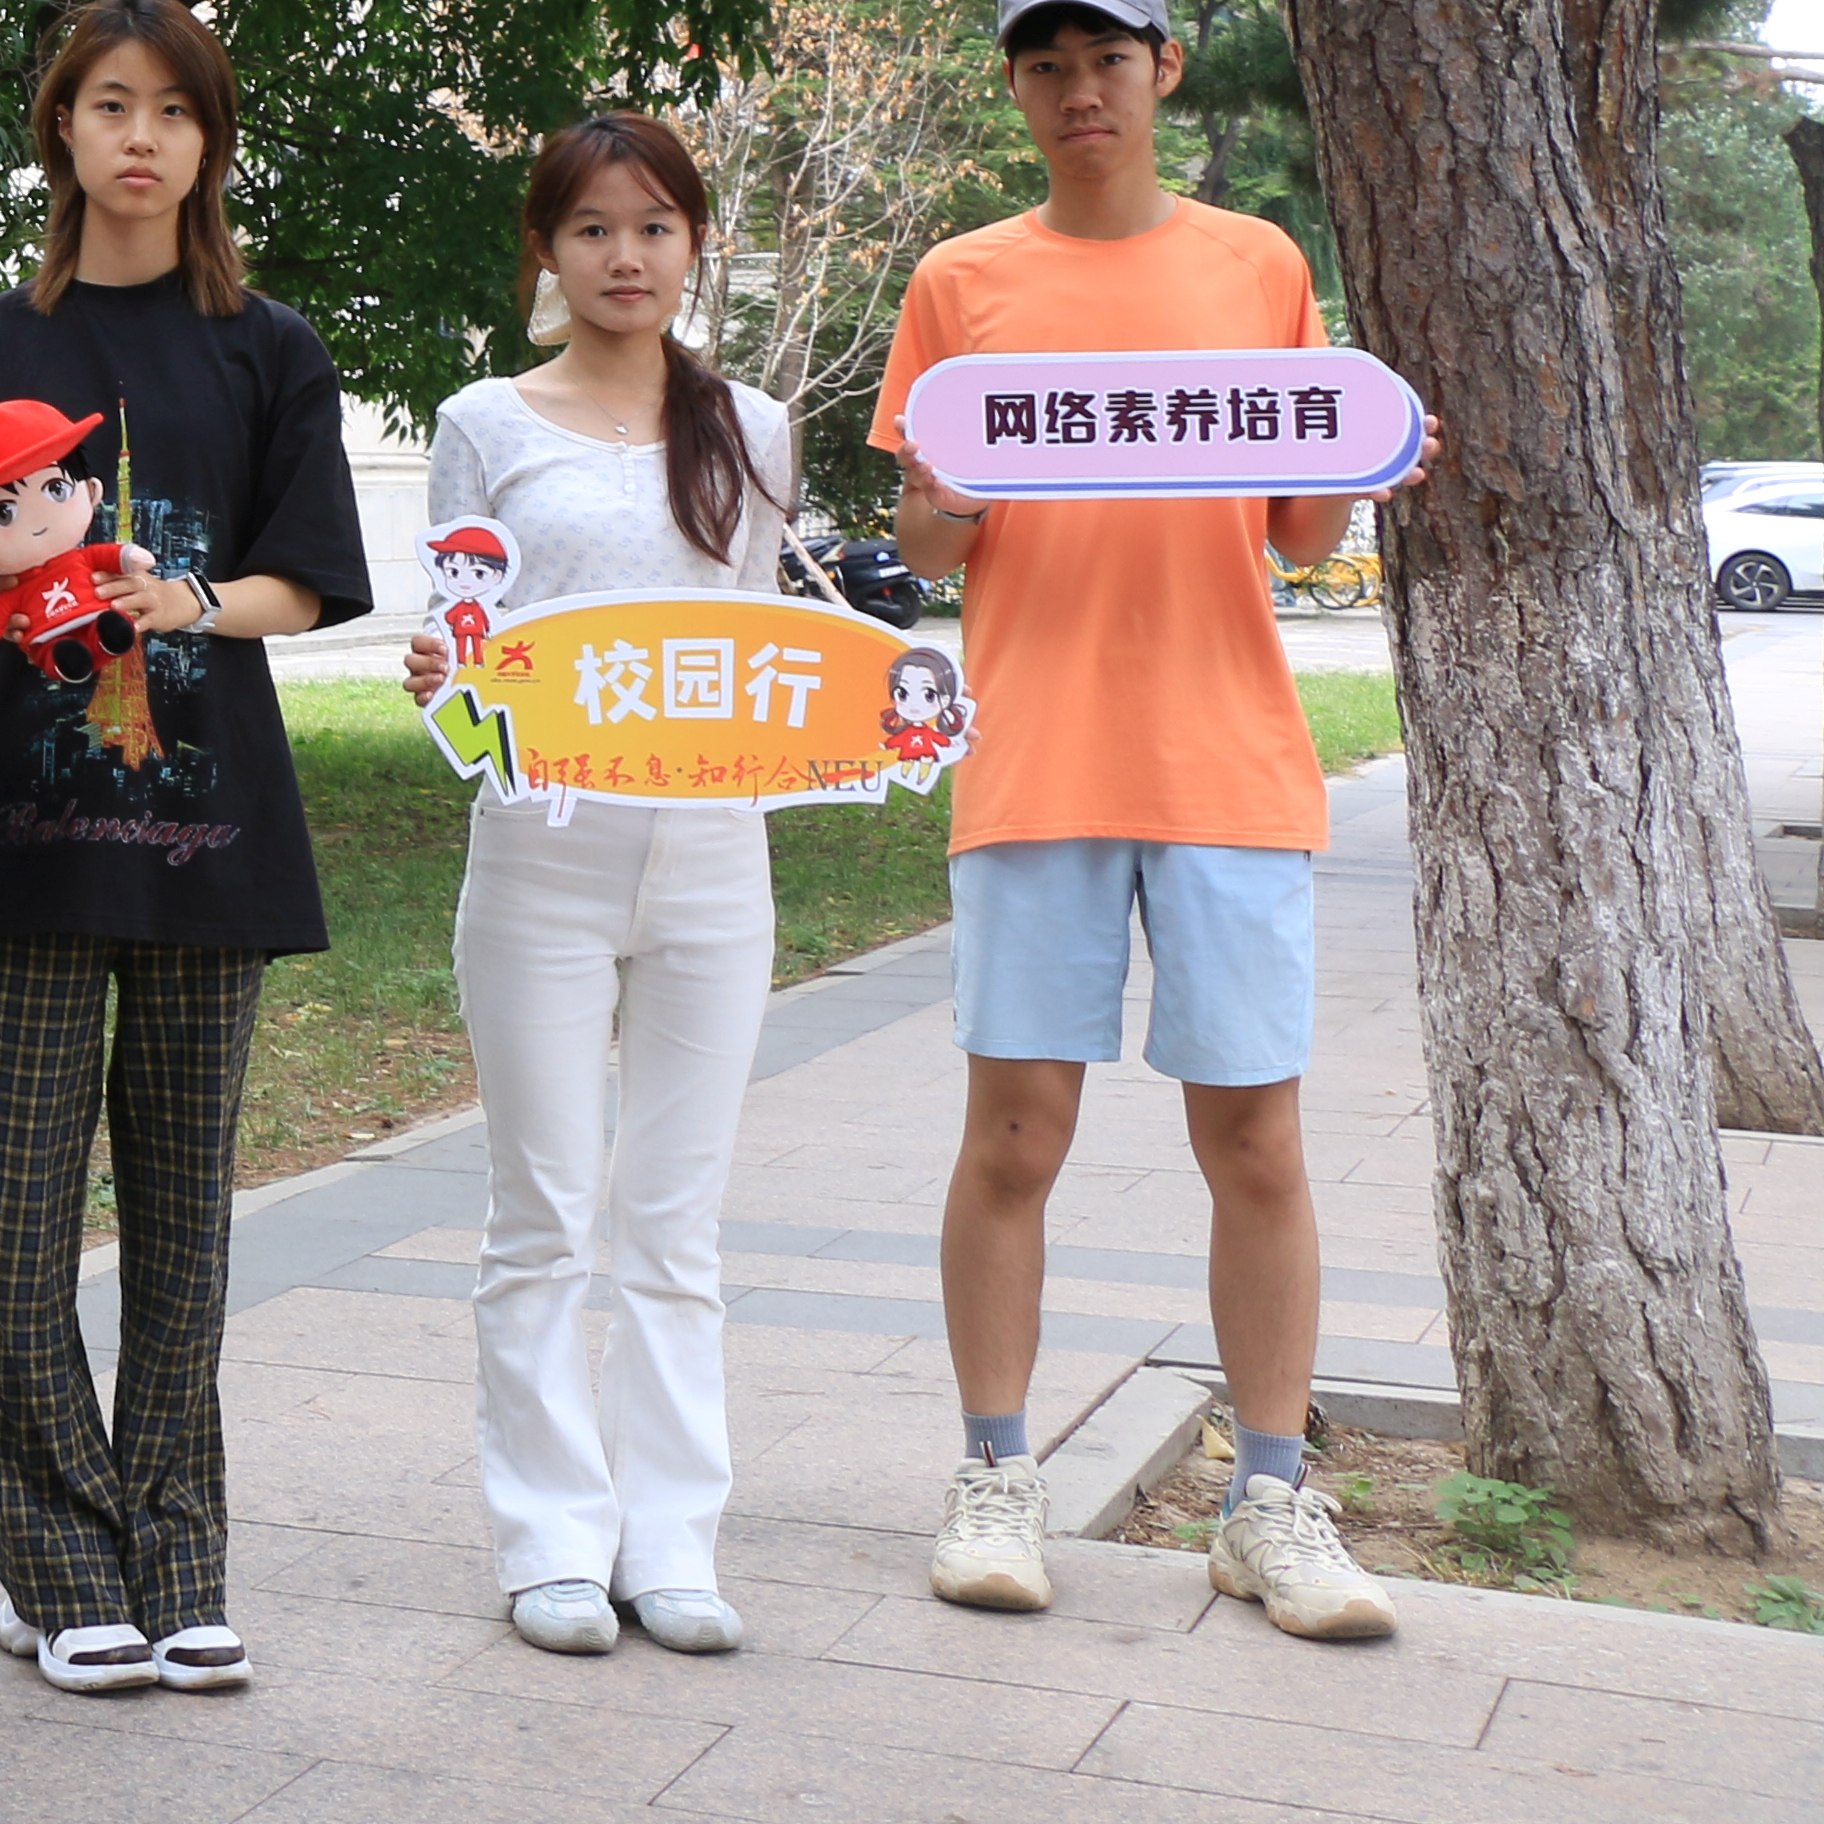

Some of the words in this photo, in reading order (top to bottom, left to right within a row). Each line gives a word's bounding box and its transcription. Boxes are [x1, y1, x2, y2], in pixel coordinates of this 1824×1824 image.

[984, 385, 1343, 445] 网络素养培育
[574, 638, 822, 728] 校园行
[805, 759, 884, 793] NEU
